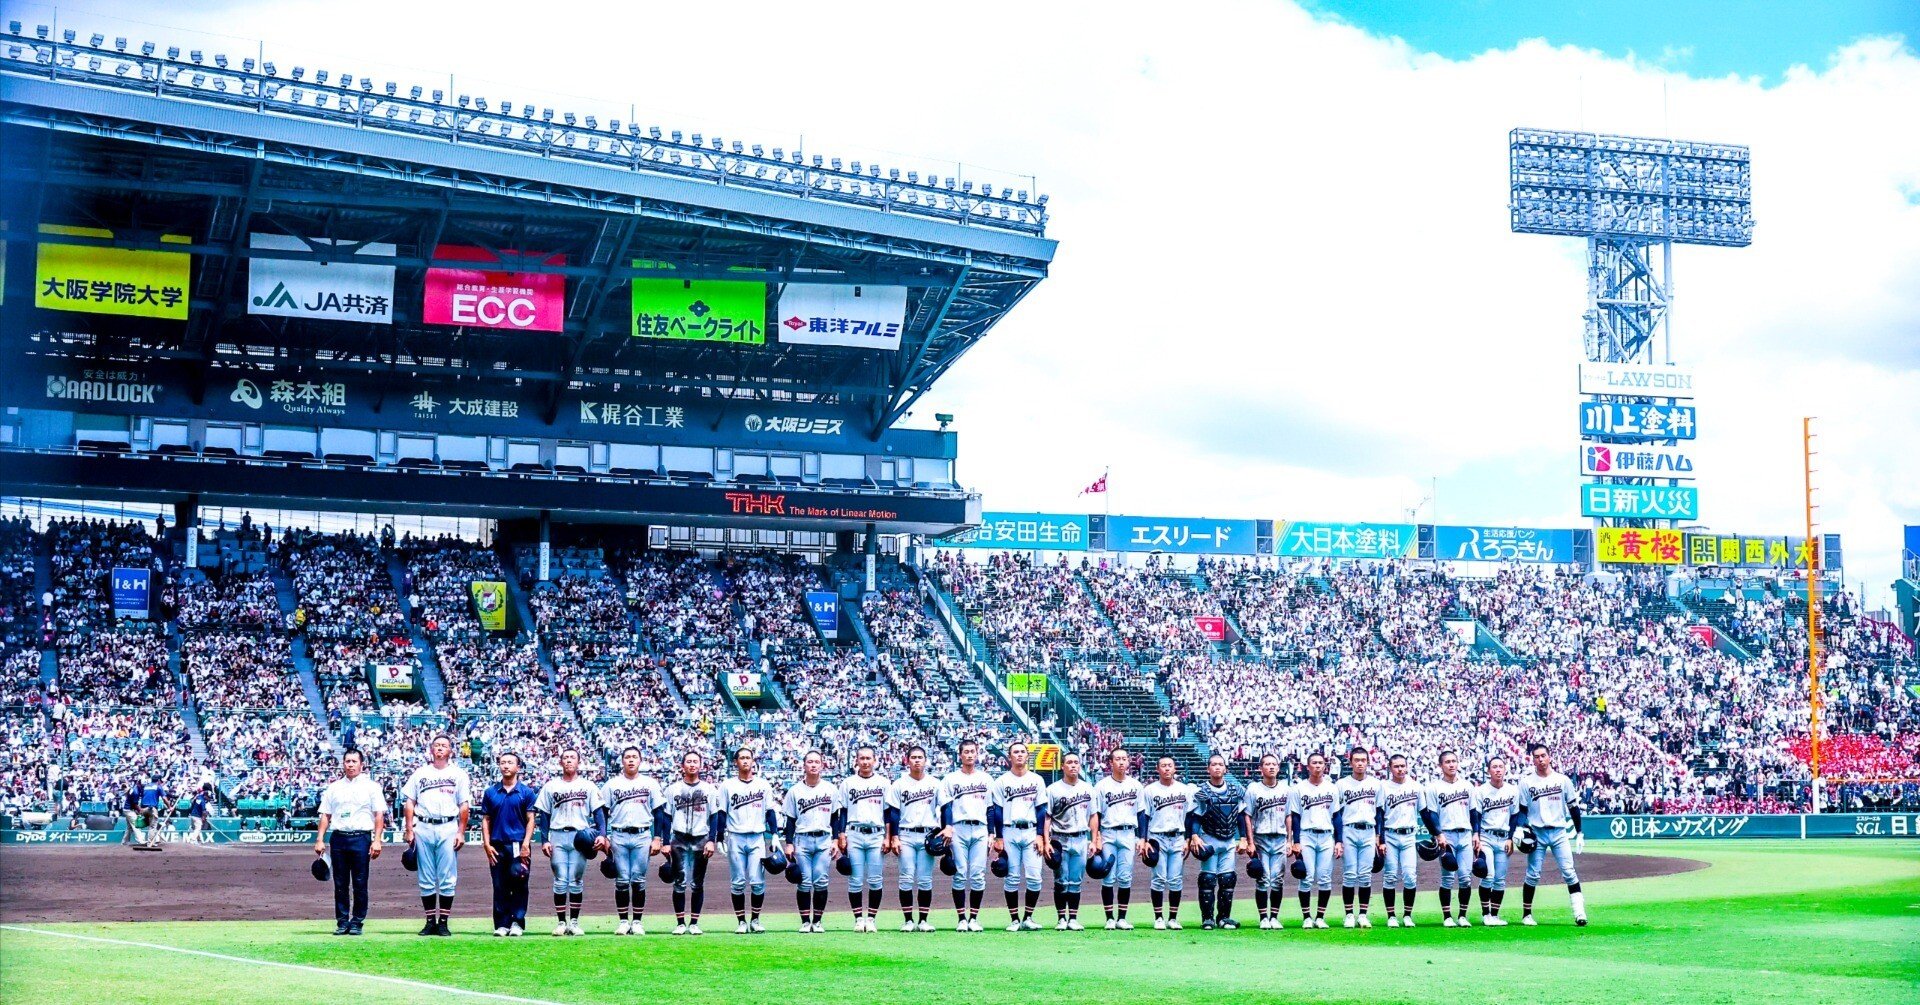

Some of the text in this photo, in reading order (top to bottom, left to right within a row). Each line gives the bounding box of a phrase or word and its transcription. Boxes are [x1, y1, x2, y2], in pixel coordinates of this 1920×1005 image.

[42, 277, 182, 307] 大阪学院大学
[304, 292, 389, 315] JA共済
[452, 293, 536, 326] ECC
[637, 313, 760, 340] 住友ベークライト
[809, 317, 899, 337] 東洋アルミ
[1607, 371, 1692, 389] LAWSON
[270, 379, 346, 405] 森本組
[283, 404, 346, 416] Quality Always
[449, 398, 519, 418] 大成建設
[601, 403, 684, 428] 梶谷工業
[764, 417, 844, 435] 大阪シミズ
[1585, 404, 1695, 436] 川上塗料
[1615, 452, 1693, 471] 伊藤ハム
[725, 493, 897, 519] THK The Mark of Linear Motion
[1590, 487, 1692, 515] 日新火災
[1130, 525, 1232, 549] エスリード
[1291, 527, 1400, 556] 大日本塗料
[1483, 529, 1535, 539] 生活応援バンク
[1483, 539, 1554, 561] ろうきん
[1617, 530, 1681, 561] 黄桜
[49, 832, 107, 842] ダイドードリンコ
[267, 833, 312, 842] ウエルシア
[1631, 816, 1749, 838] 日本ハウズイング
[1855, 822, 1886, 835] SGL.
